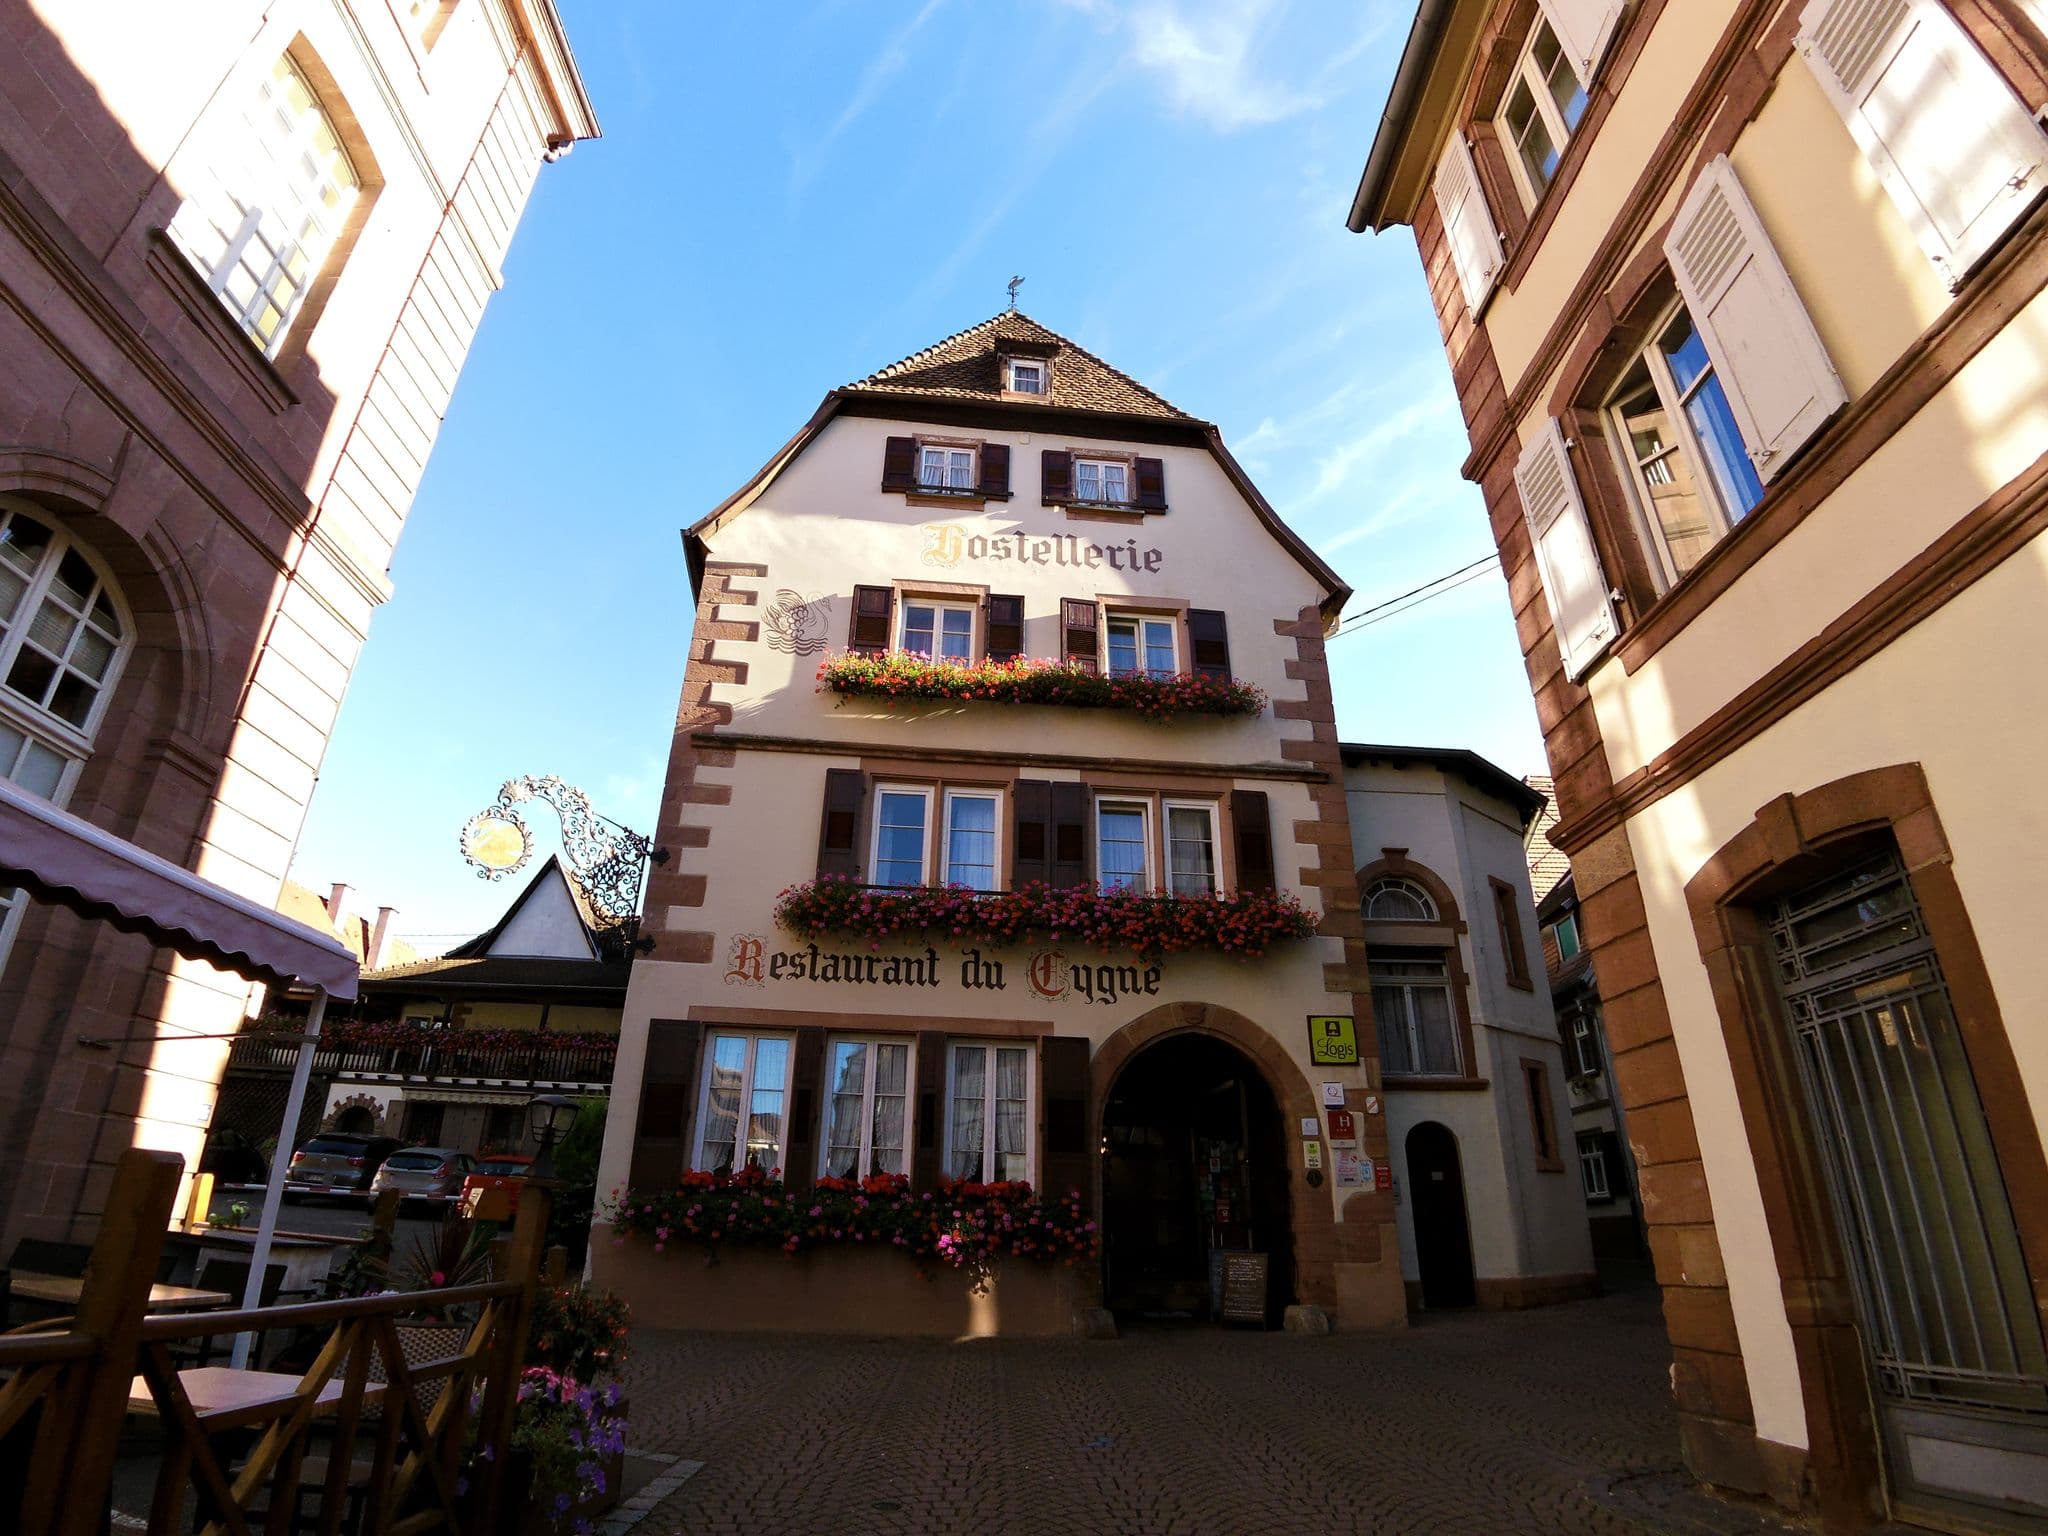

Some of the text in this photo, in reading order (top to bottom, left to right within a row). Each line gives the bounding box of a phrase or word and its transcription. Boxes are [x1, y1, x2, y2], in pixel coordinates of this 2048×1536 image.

[921, 523, 1162, 574] Hostellerie
[724, 934, 1162, 1005] Restaurant du Cygne
[1317, 1038, 1354, 1059] Logis
[1339, 1115, 1350, 1127] H
